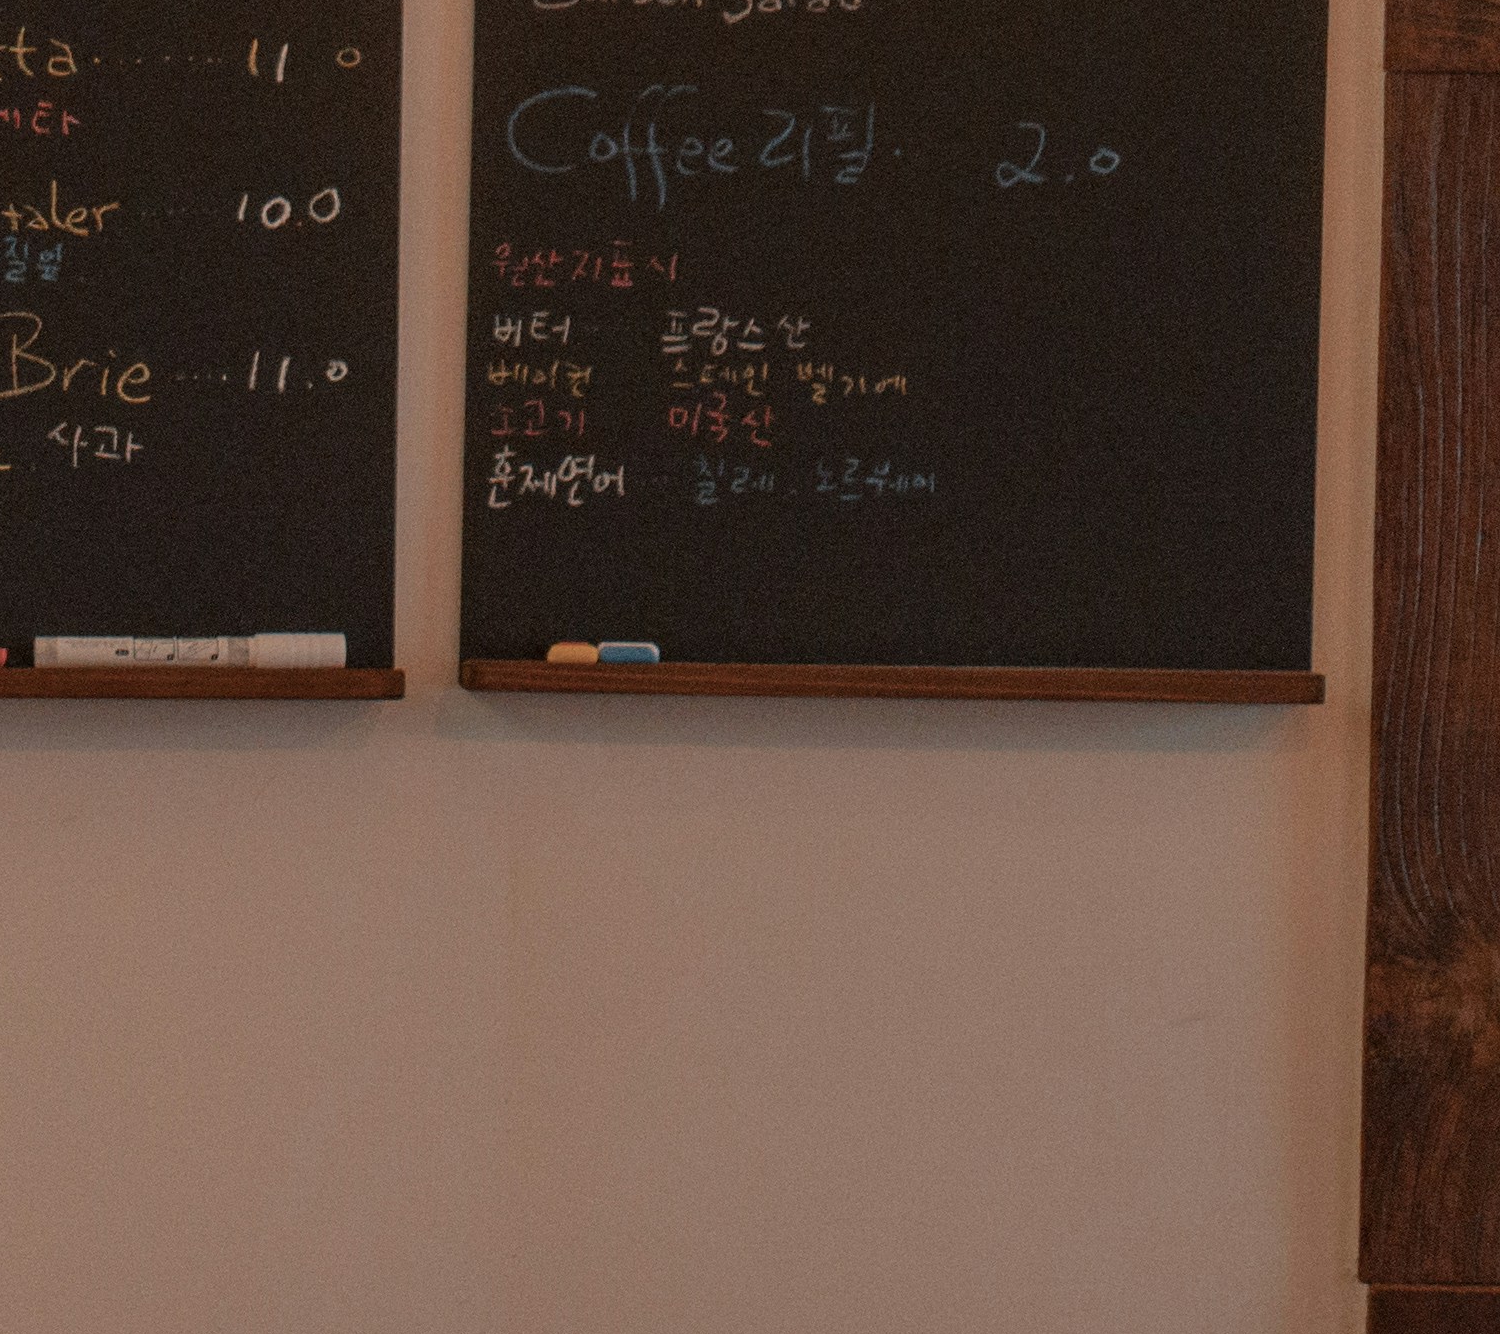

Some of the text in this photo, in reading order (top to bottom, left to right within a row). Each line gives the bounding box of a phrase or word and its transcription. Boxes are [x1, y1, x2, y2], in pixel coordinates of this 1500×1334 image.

[507, 84, 1120, 210] Coffee 리필 2.0
[493, 310, 571, 347] 버터
[248, 350, 348, 392] 11.0
[488, 359, 592, 398] 베이컨
[796, 361, 907, 406] 벨기에
[667, 391, 775, 448] 미국산
[48, 422, 144, 469] 사과
[487, 444, 626, 509] 훈제연어
